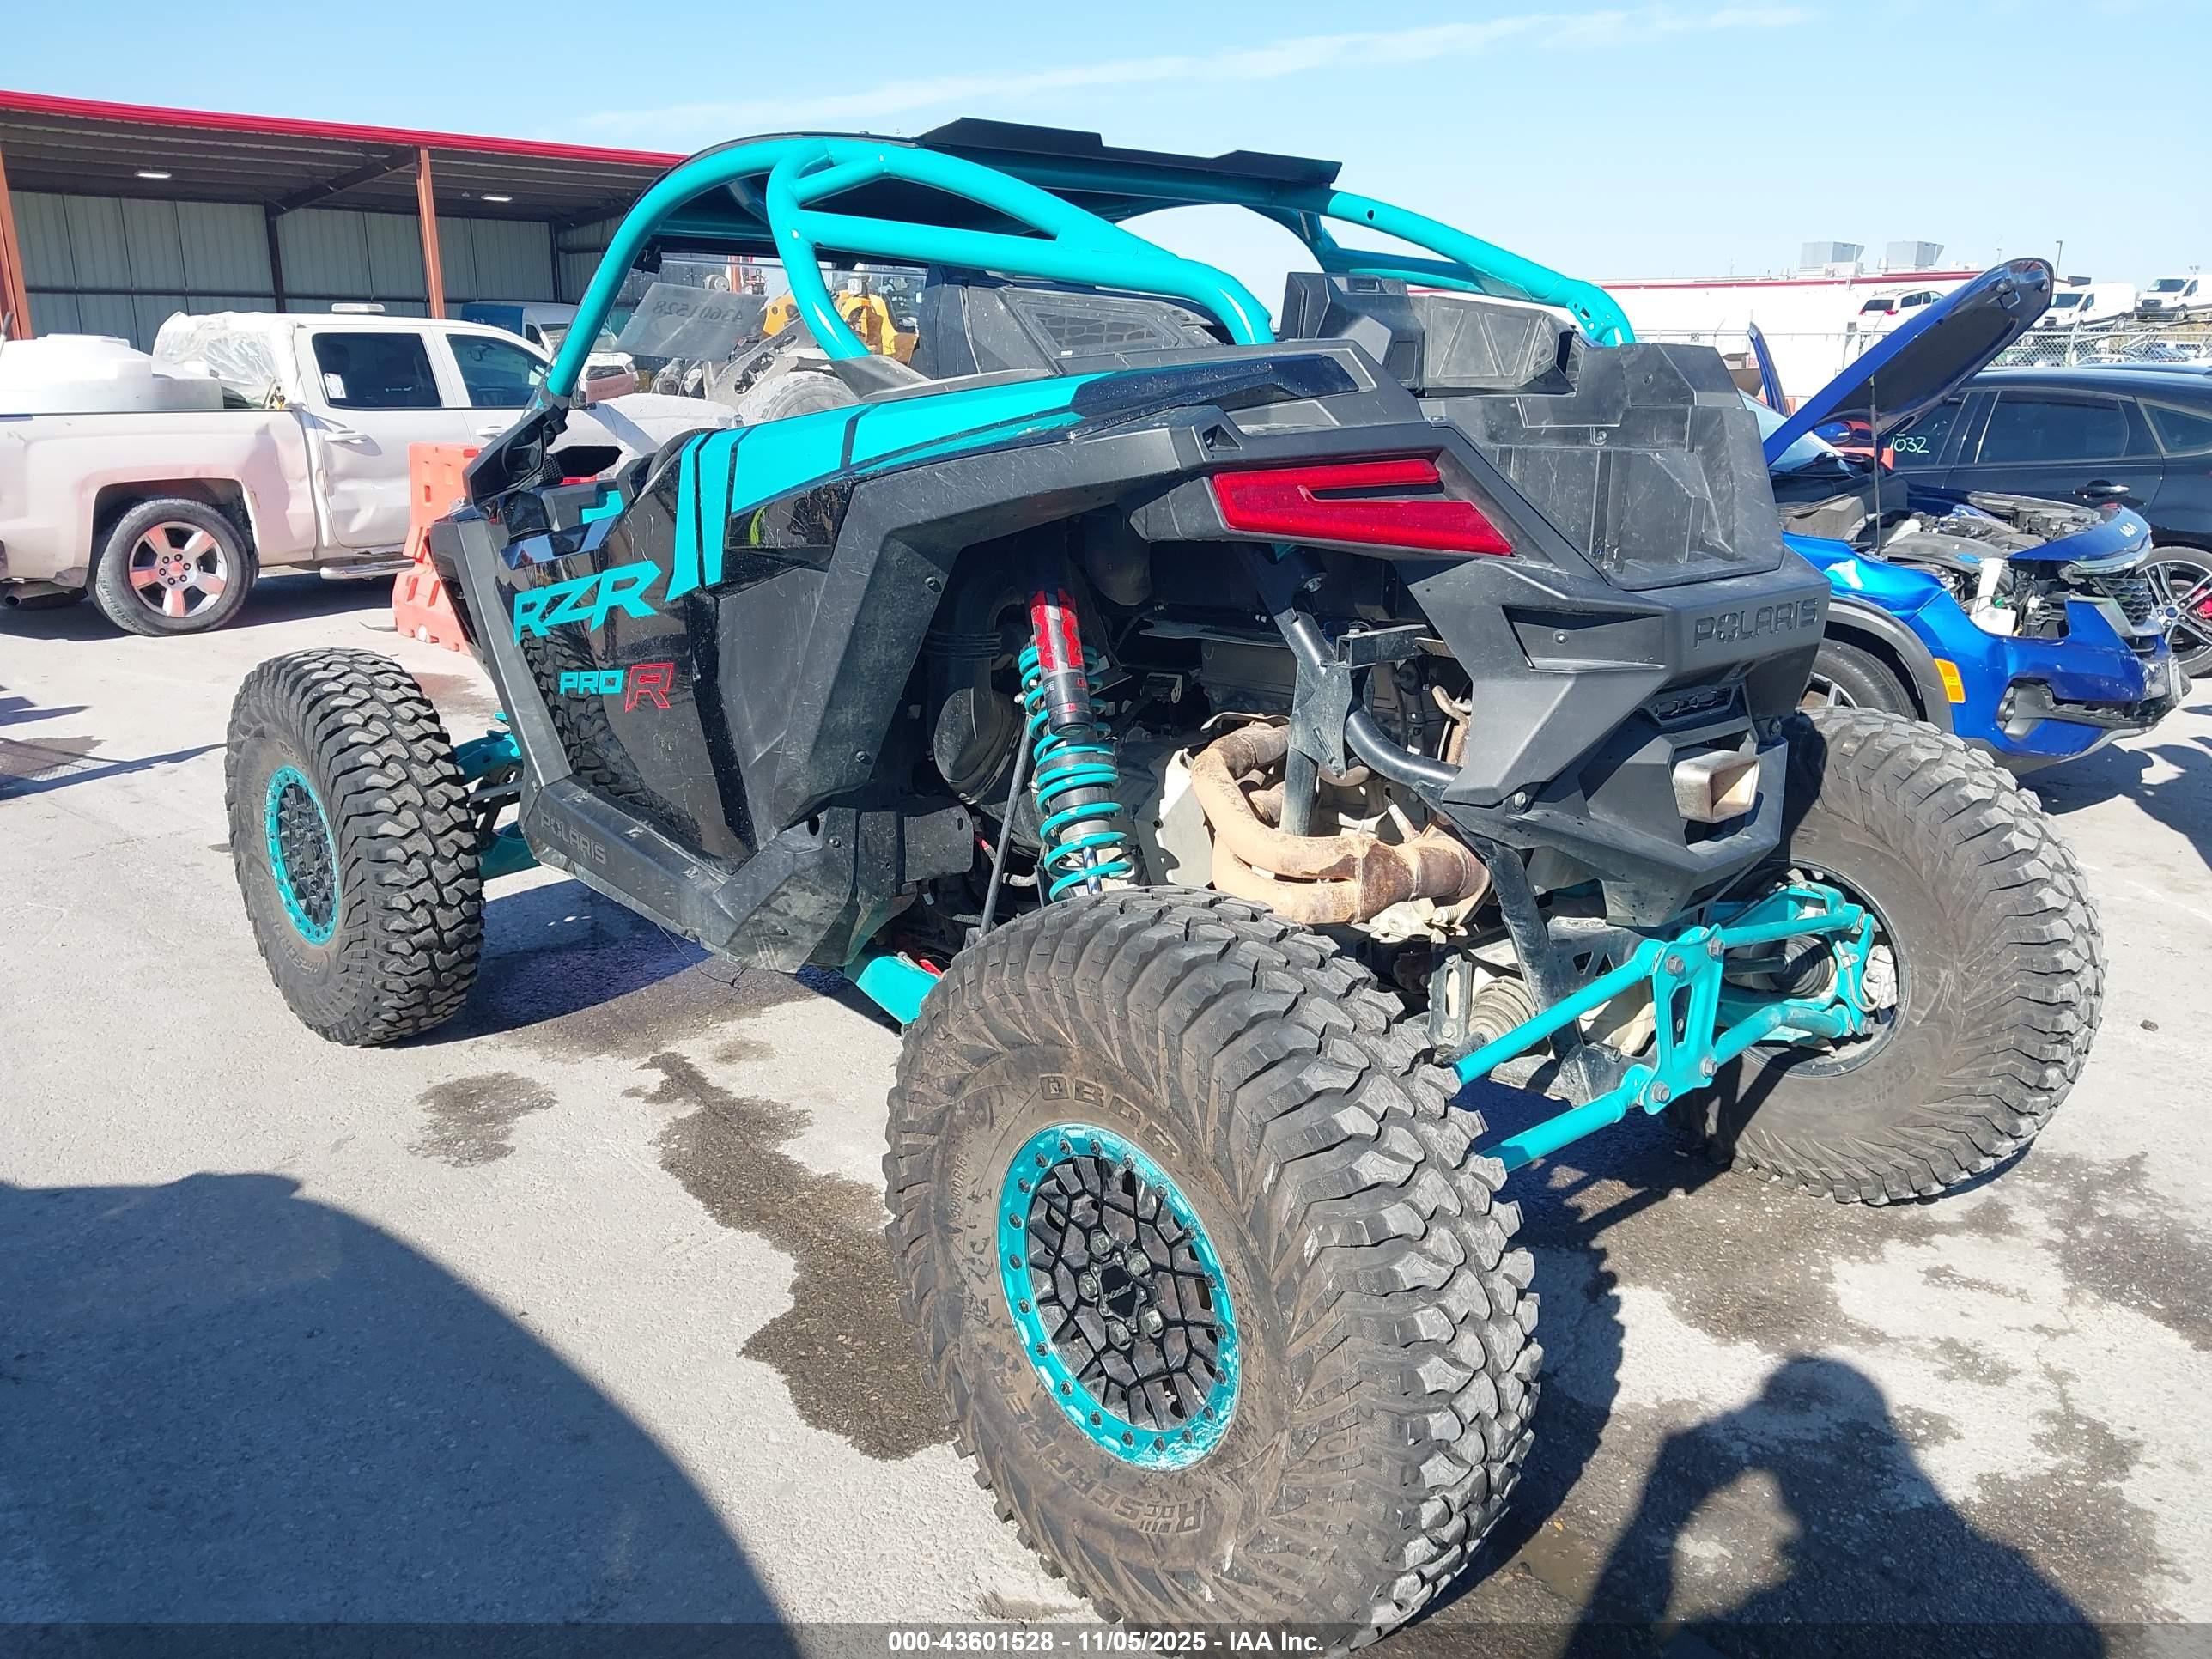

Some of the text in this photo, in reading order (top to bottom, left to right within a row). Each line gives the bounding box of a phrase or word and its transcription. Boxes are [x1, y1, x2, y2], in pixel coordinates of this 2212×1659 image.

[514, 560, 662, 647] RZR
[1694, 598, 1819, 650] POLARIS
[559, 662, 675, 714] PRO R
[540, 813, 606, 866] POLARIS
